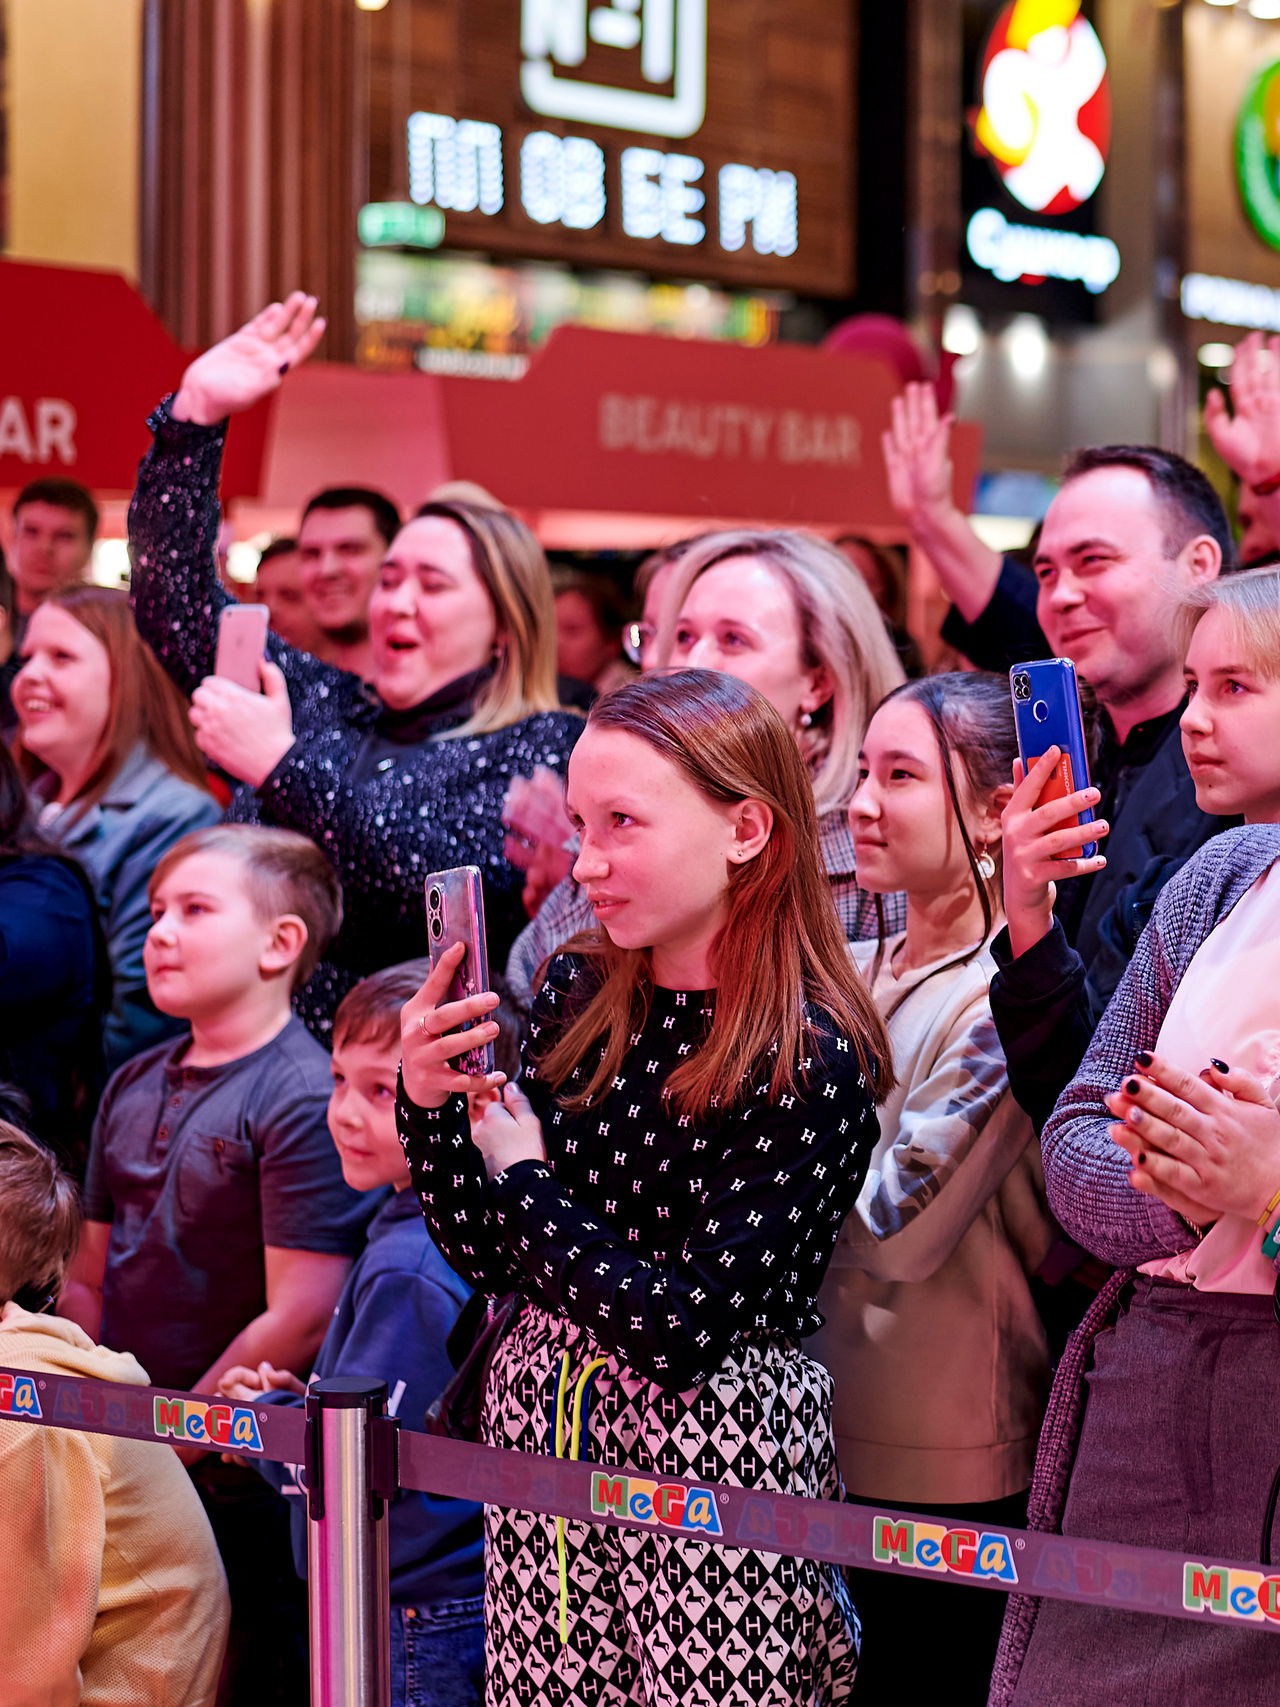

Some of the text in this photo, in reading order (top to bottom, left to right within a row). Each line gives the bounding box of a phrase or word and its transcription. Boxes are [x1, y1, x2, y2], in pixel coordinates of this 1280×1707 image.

[601, 394, 860, 467] BEAUTY BAR
[1062, 759, 1071, 796] TINKOF
